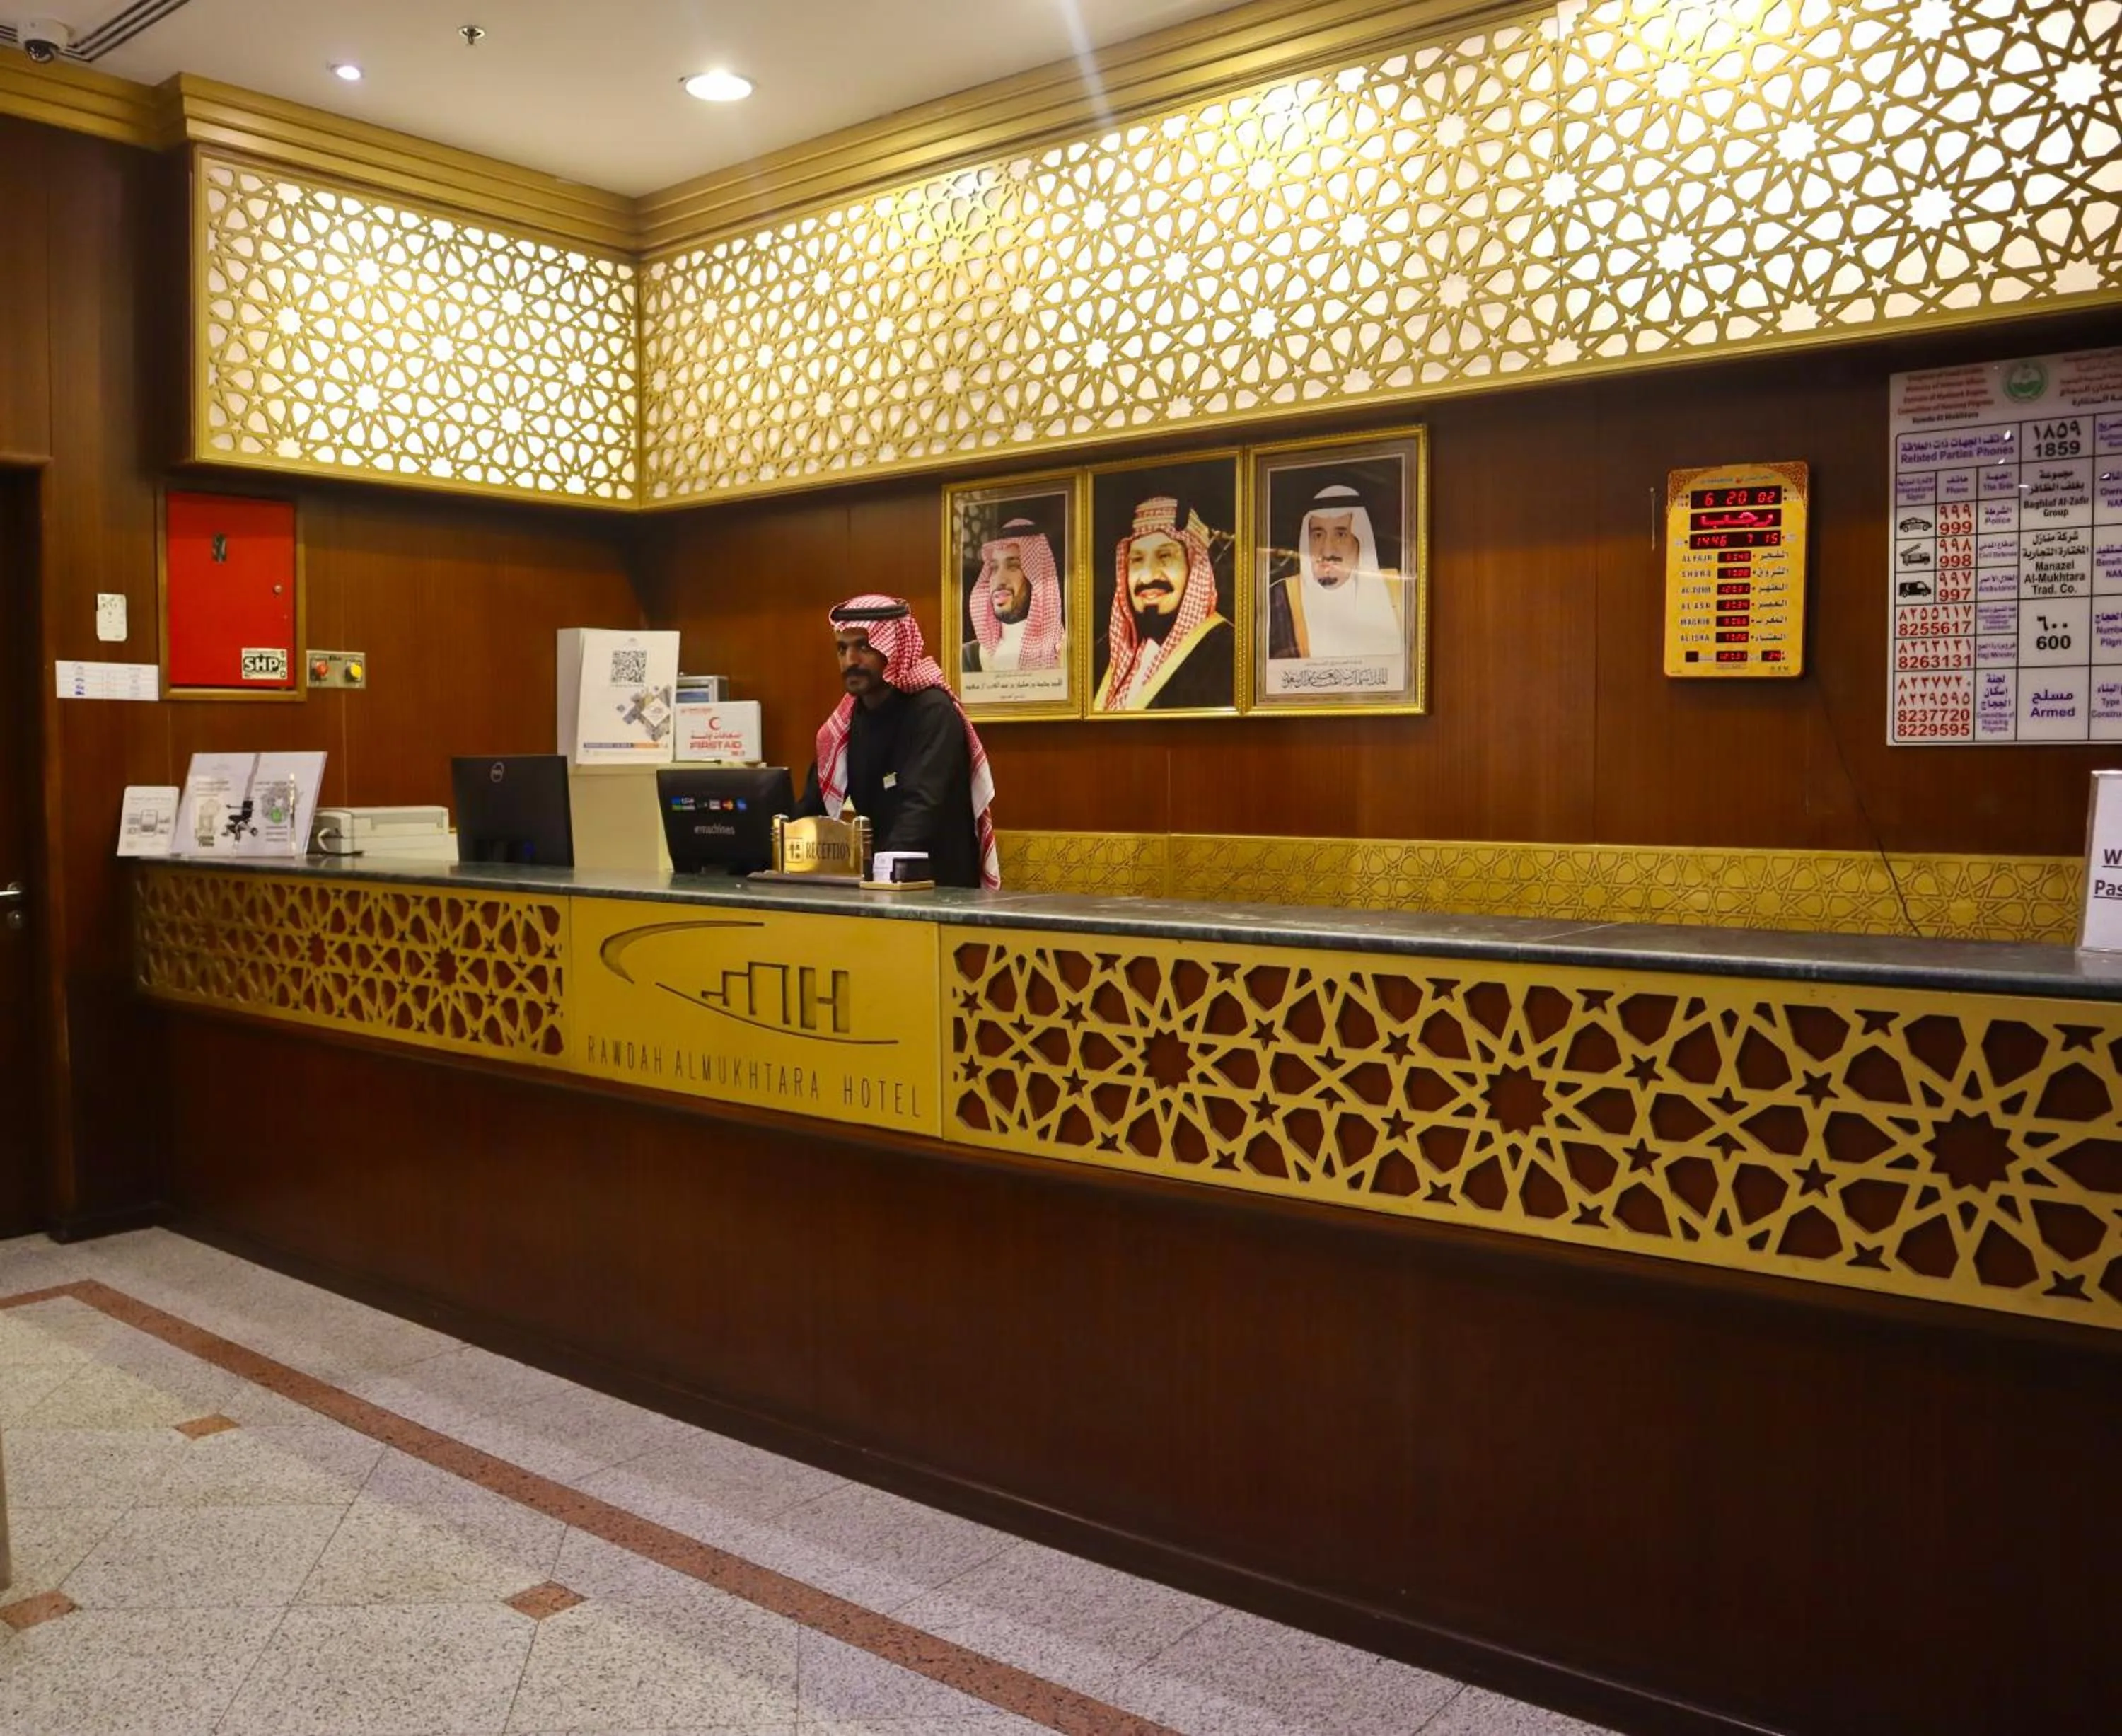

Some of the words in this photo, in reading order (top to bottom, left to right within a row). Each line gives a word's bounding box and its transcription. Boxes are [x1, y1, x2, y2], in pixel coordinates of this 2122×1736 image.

[2034, 419, 2082, 440] ١٨٥٩
[1901, 451, 1937, 464] Related
[1940, 448, 1973, 459] Parties
[1976, 445, 2014, 456] Phones
[2034, 439, 2081, 458] 1859
[1940, 504, 1971, 520] ٩٩٩
[2043, 509, 2069, 518] Group
[1700, 512, 1773, 529] رجب
[1940, 521, 1972, 535] 999
[1697, 536, 1727, 547] 1446
[1939, 538, 1972, 552] ٩٩٨
[1940, 554, 1972, 567] 998
[1939, 571, 1971, 586] ٩٩٧
[2024, 572, 2086, 584] Al-Mukhtara
[1939, 588, 1971, 602] 997
[2031, 585, 2056, 595] Trad.
[2059, 584, 2077, 594] Co.
[1899, 606, 1971, 622] ٨٢٥٥٦١٧
[1898, 620, 1971, 636] 8255617
[1898, 639, 1971, 654] ٨٢٦٣١٣١
[2036, 635, 2072, 650] 600
[243, 656, 280, 672] SHP
[1898, 654, 1971, 669] 8263131
[1898, 676, 1971, 690] ٨٢٣٧٧٢٠
[1898, 692, 1971, 707] ٨٢٢٩٥٩٥
[2032, 689, 2074, 704] مسلح
[2101, 698, 2120, 707] Type
[1898, 709, 1970, 722] 8237720
[2031, 708, 2075, 718] Armed
[1898, 723, 1970, 737] 8229595
[806, 841, 850, 861] RECEPTION
[588, 1035, 662, 1076] RAWDAH
[674, 1048, 818, 1101] ALMUKHTARA
[843, 1074, 920, 1118] HOTEL
